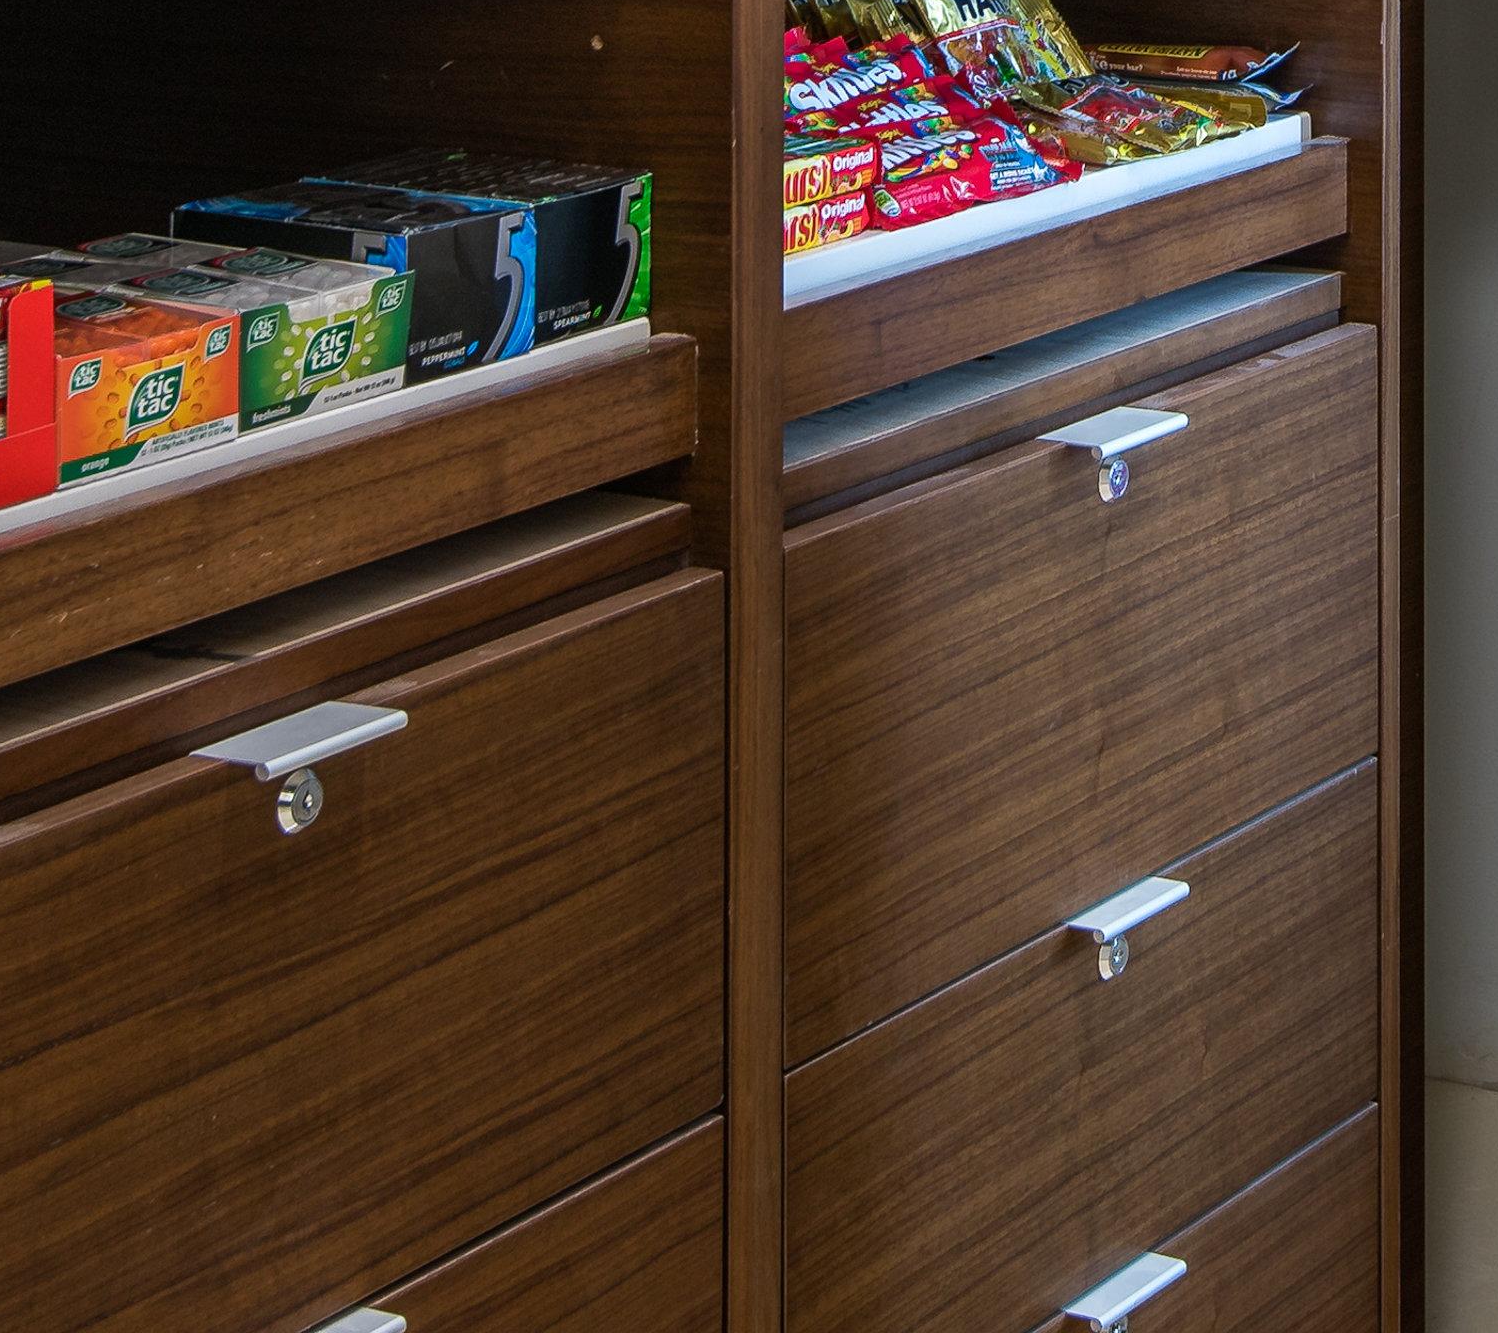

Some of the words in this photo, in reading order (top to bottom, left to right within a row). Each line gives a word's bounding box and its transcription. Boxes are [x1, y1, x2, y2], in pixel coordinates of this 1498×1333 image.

[788, 61, 903, 112] Skittles
[832, 146, 875, 174] Original
[319, 330, 350, 352] tic
[310, 346, 344, 370] tac
[145, 374, 178, 400] tic
[136, 394, 173, 419] tac
